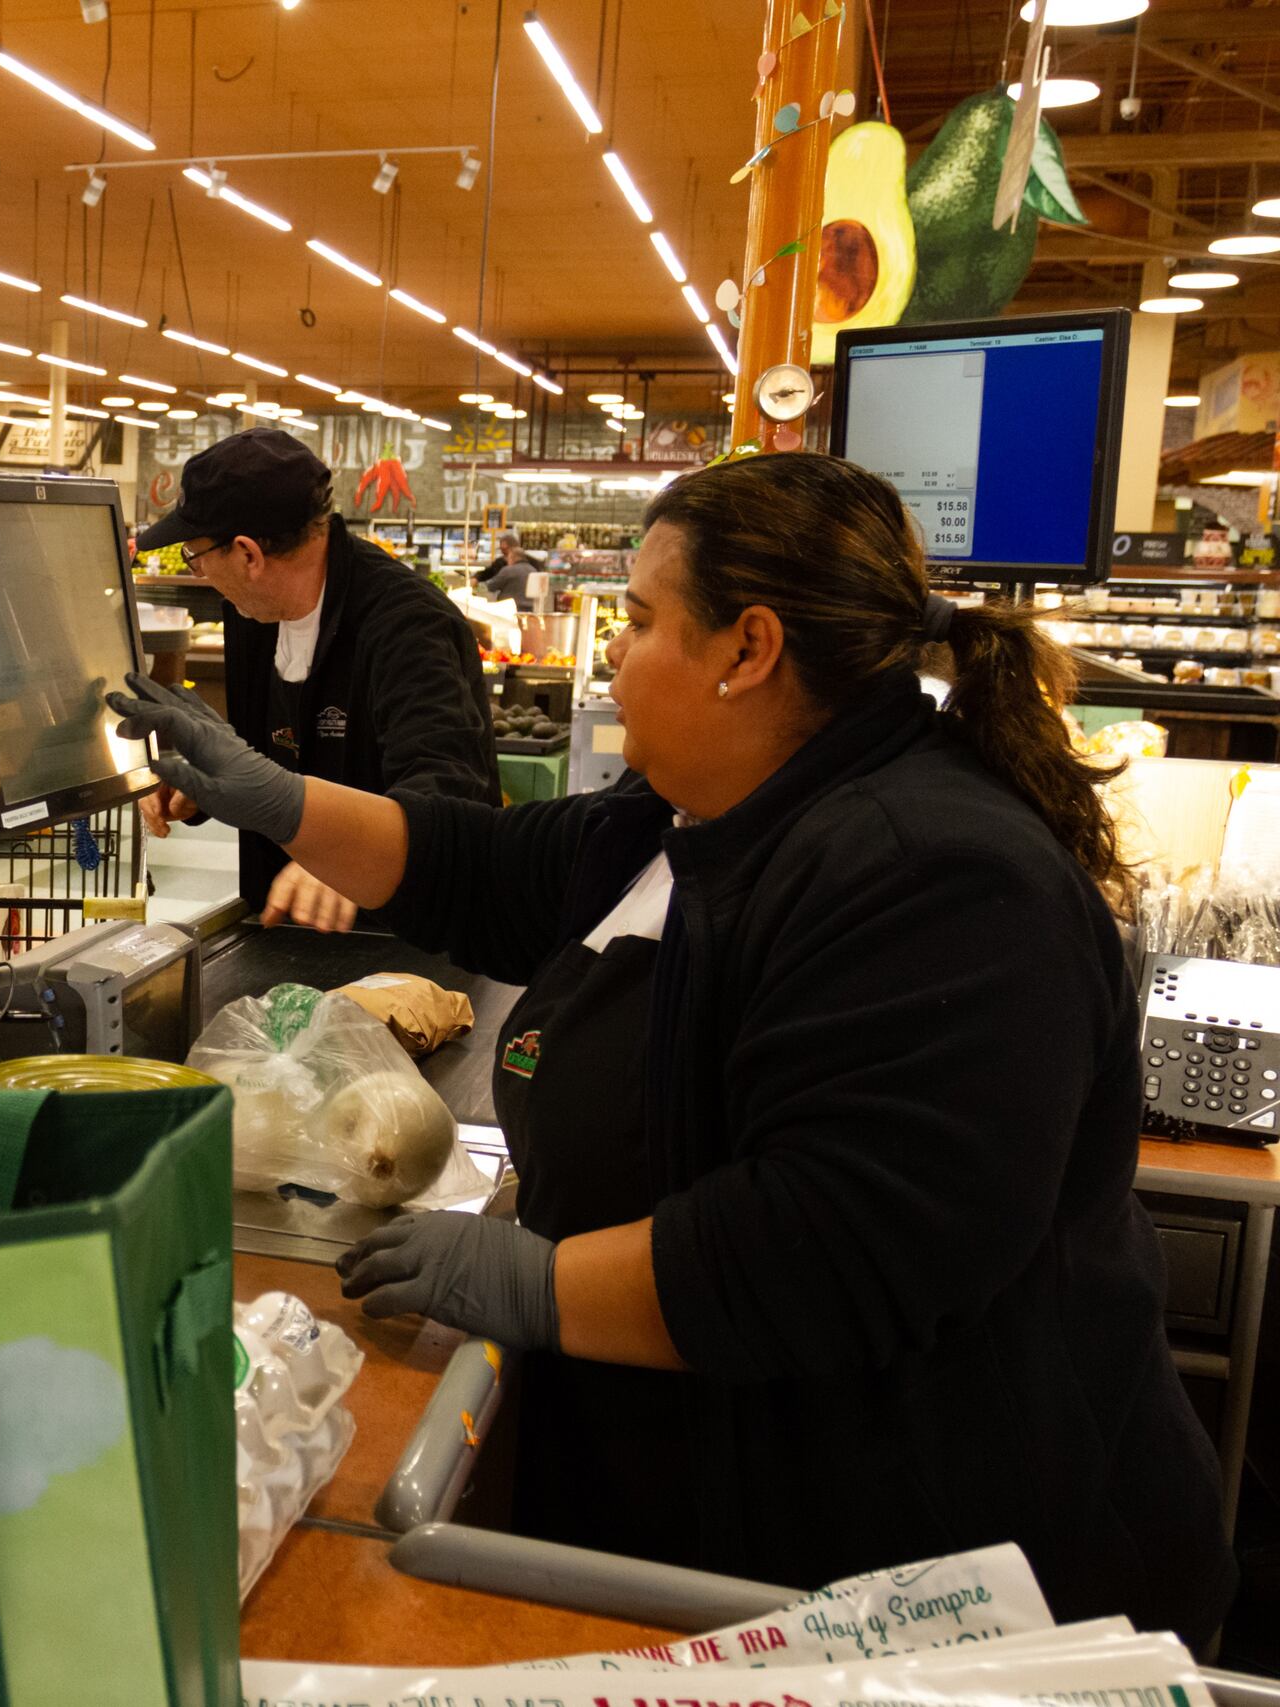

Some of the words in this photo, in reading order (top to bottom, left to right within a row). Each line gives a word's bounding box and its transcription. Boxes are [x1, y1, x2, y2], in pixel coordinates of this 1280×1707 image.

[937, 501, 968, 511] $15.58
[940, 517, 966, 527] $0.00
[935, 533, 966, 543] $15.58
[803, 1611, 865, 1651] Hoy
[869, 1614, 888, 1645] y
[888, 1585, 992, 1627] Siempre
[689, 1636, 730, 1664] DE
[737, 1626, 788, 1655] 1RA
